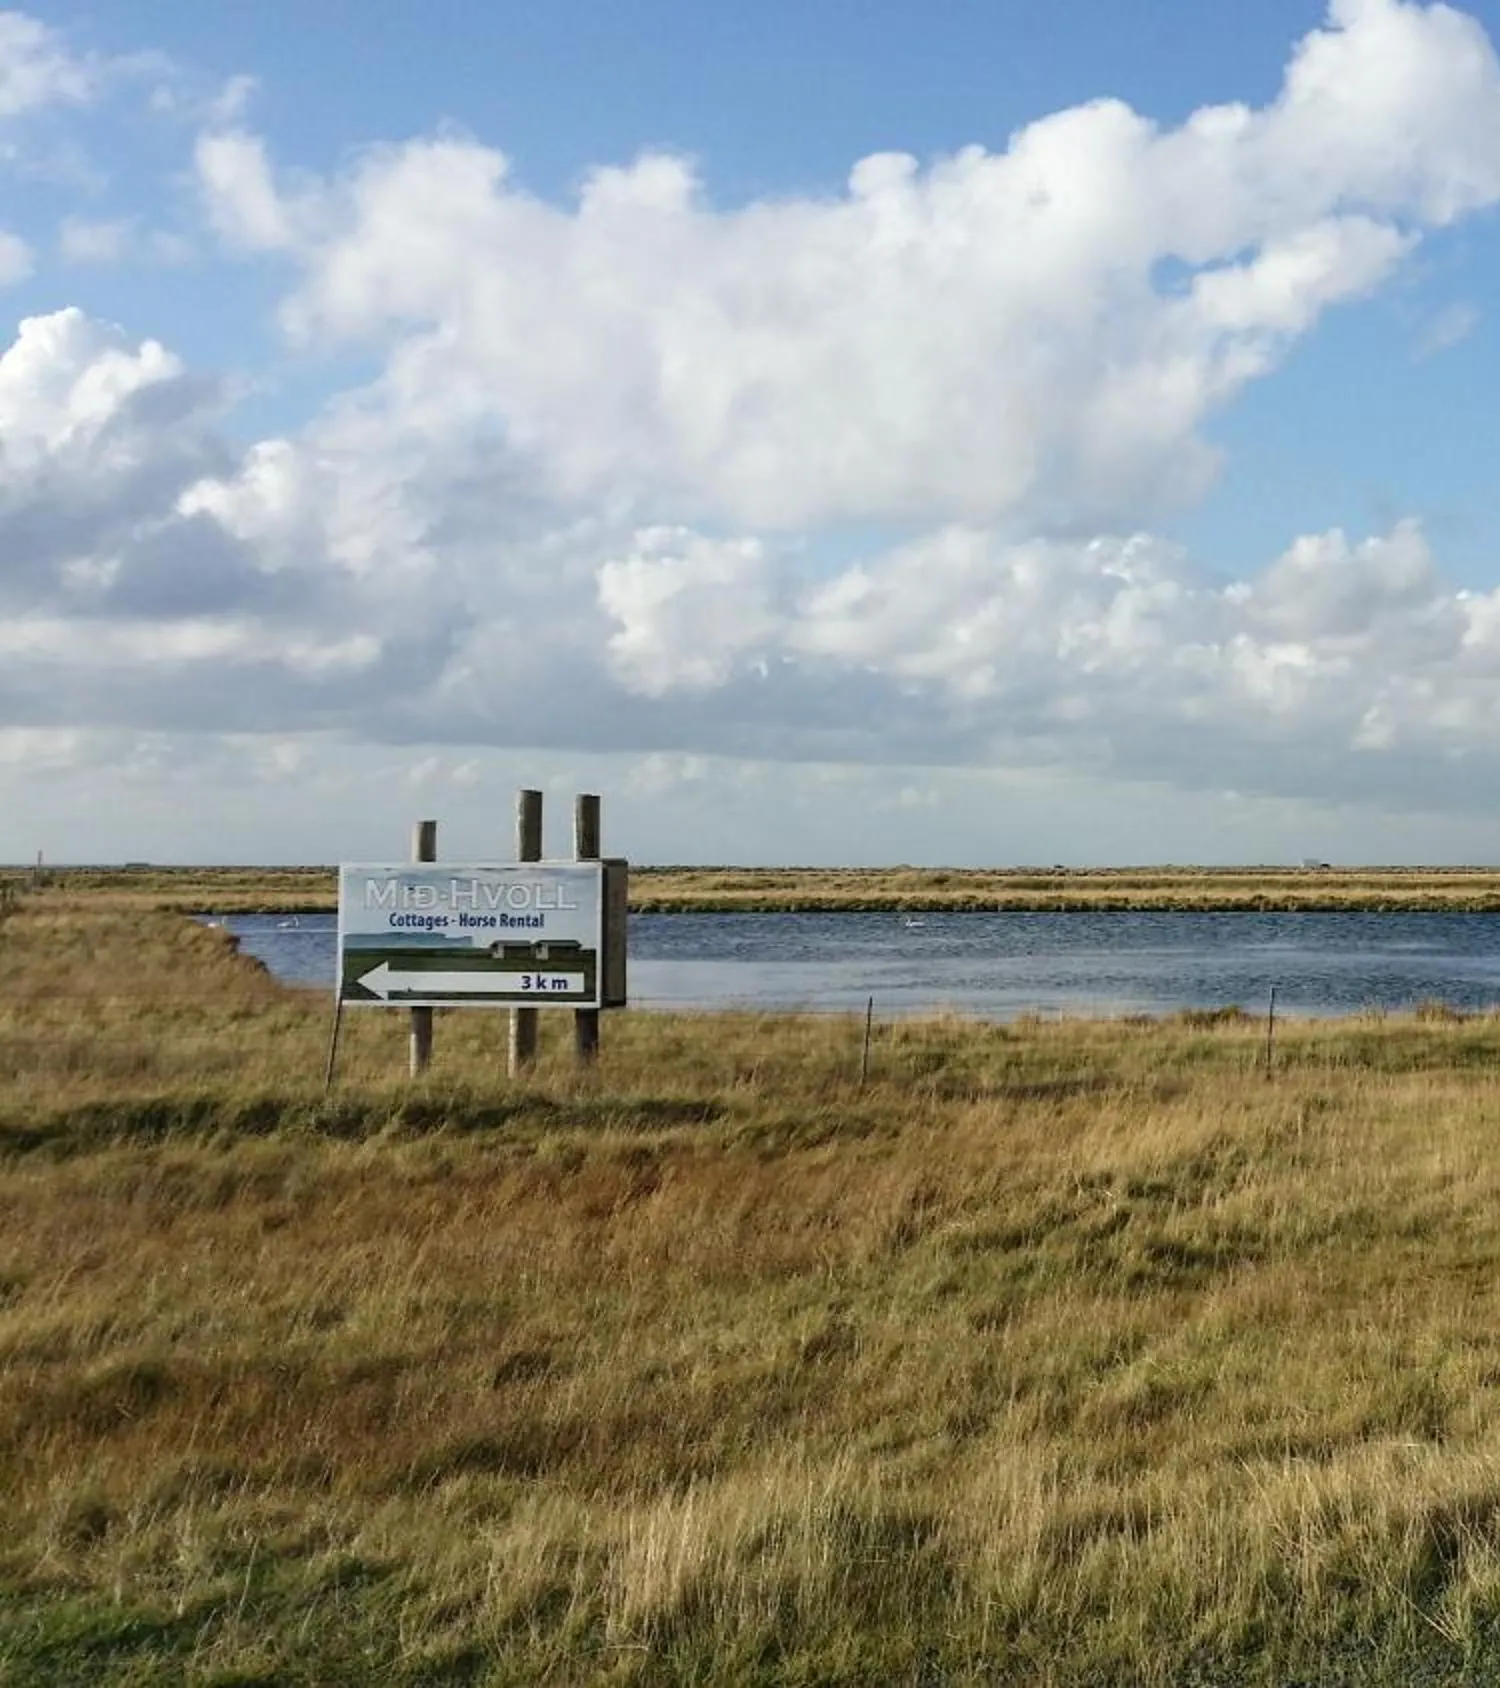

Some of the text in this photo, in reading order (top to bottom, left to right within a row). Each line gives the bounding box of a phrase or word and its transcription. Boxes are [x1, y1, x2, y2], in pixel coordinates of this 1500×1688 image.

[389, 912, 449, 931] Cottages
[459, 913, 497, 928] Horse
[499, 913, 545, 928] Rental
[521, 975, 531, 989] 3
